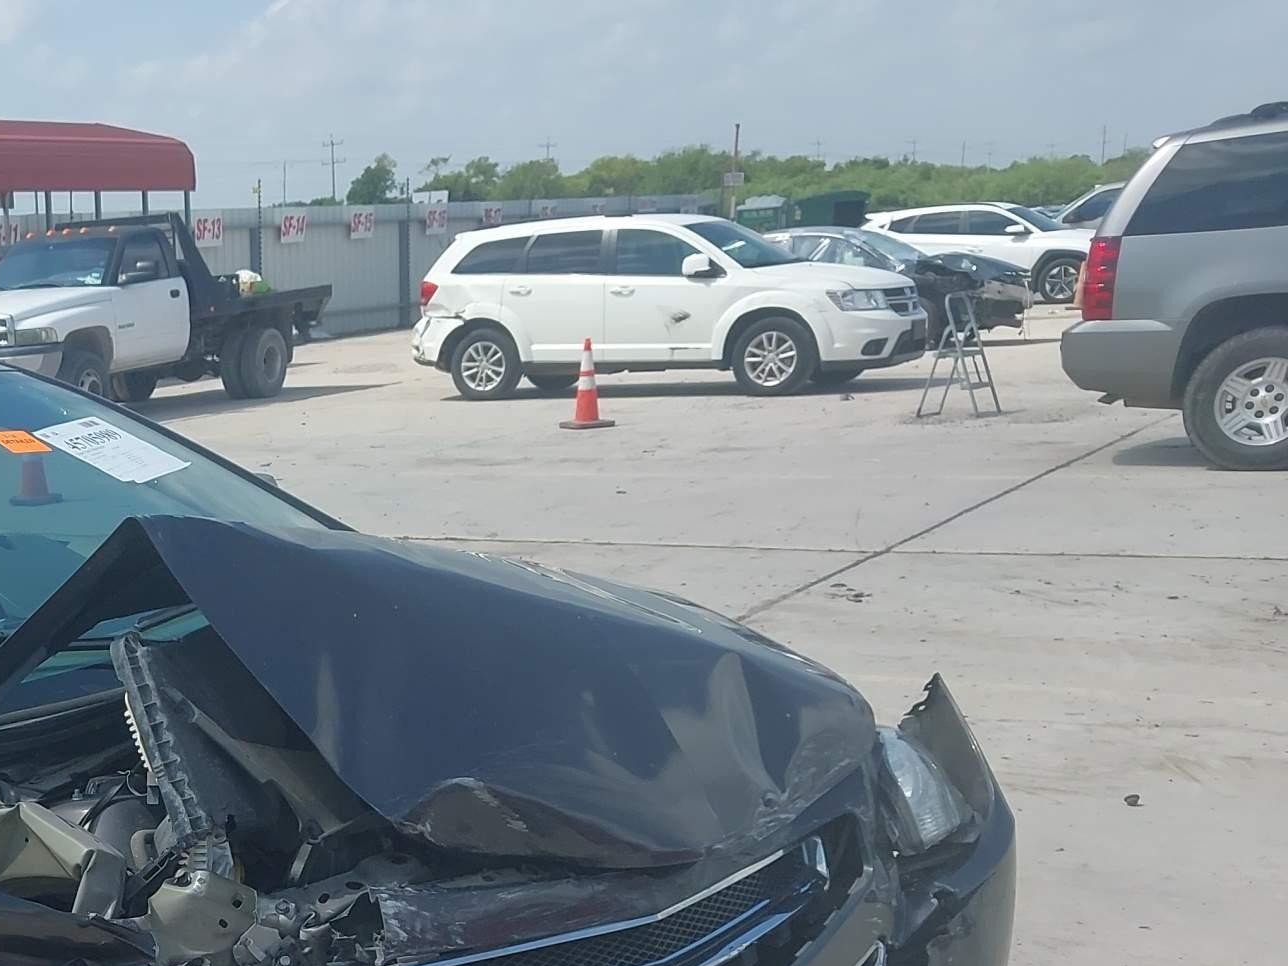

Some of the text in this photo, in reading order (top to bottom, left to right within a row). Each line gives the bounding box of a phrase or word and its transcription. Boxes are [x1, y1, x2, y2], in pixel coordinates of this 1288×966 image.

[196, 218, 221, 240] SF-13
[282, 216, 305, 236] SF-14
[352, 213, 374, 232] SF-15
